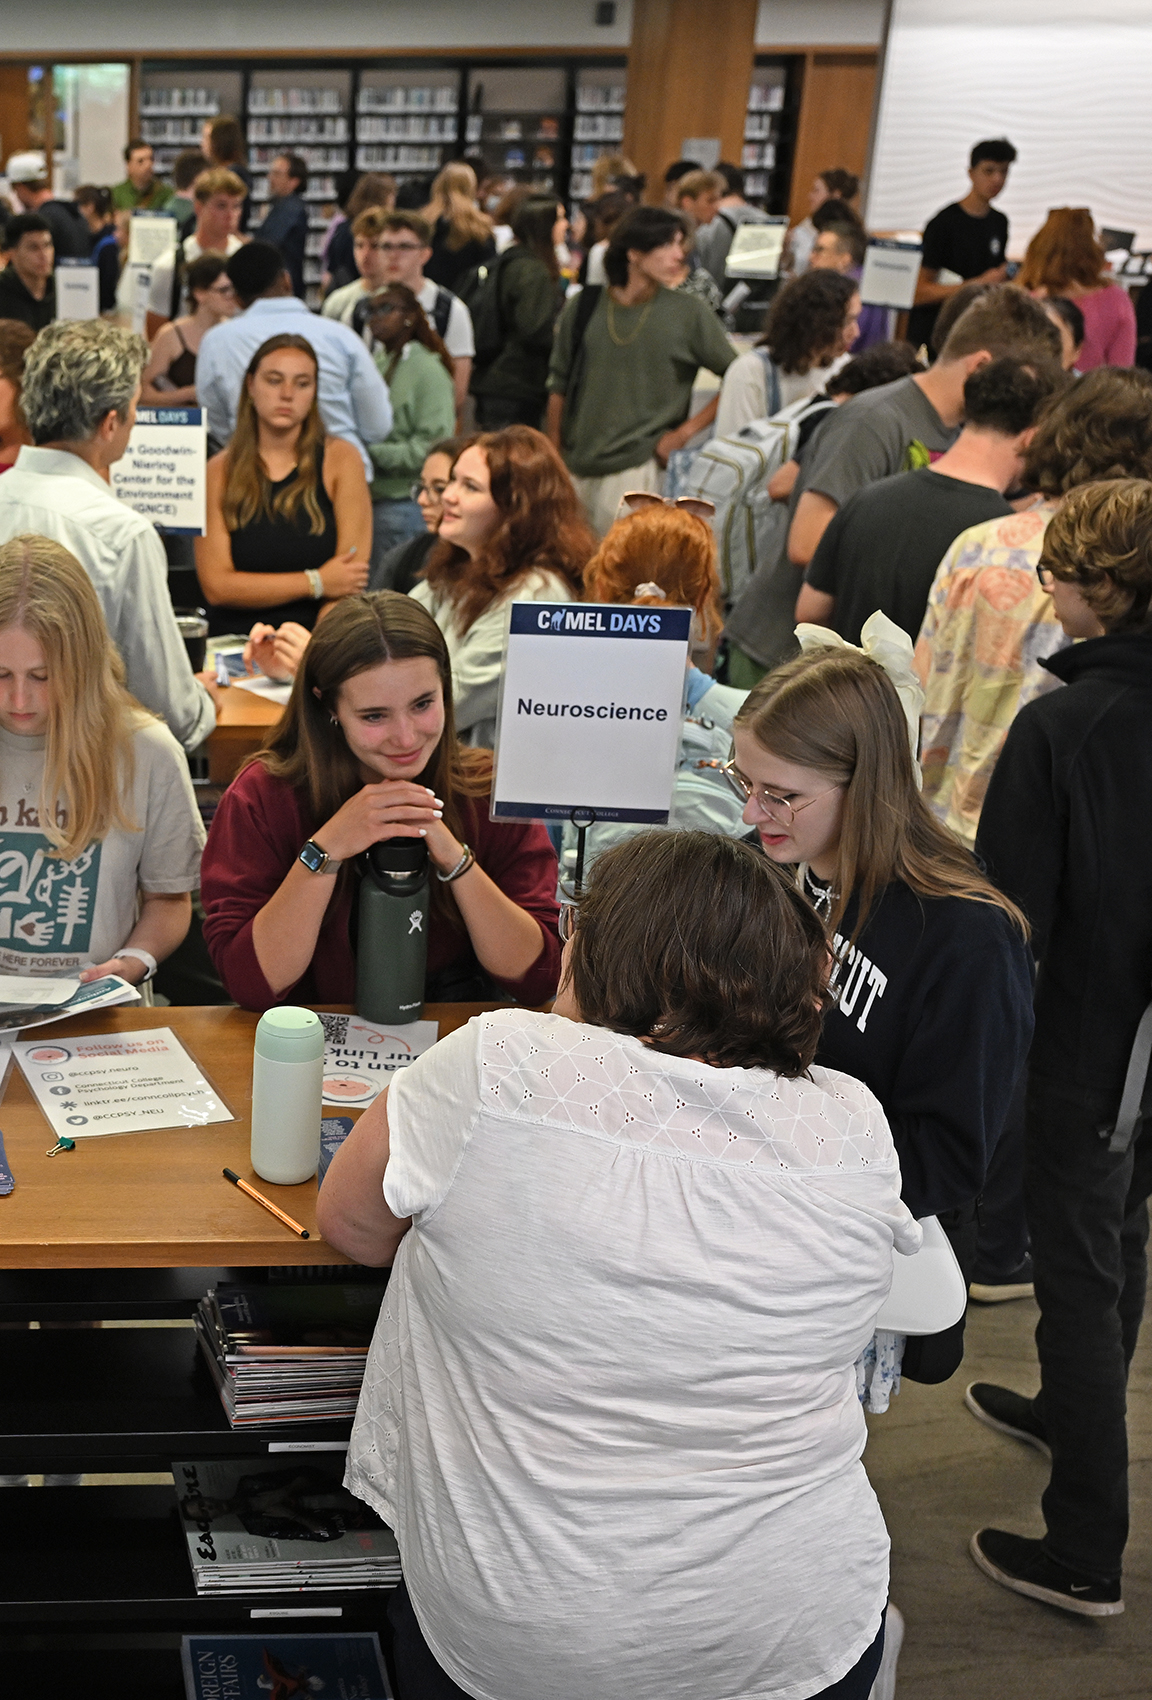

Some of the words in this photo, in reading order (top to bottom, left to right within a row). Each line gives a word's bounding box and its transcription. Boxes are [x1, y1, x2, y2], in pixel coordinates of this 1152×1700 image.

[136, 410, 158, 423] MEL
[158, 410, 189, 424] DAYS
[138, 444, 197, 454] Goodwin-
[132, 460, 176, 472] Niering
[113, 474, 152, 484] Center
[156, 474, 172, 484] for
[176, 476, 195, 485] the
[116, 488, 193, 500] Environment
[609, 613, 662, 634] DAYS
[516, 698, 668, 721] Neuroscience
[544, 807, 590, 816] CONNECICUT
[2, 954, 28, 966] HERE
[30, 957, 80, 967] FOREVER
[76, 1043, 124, 1053] Follow
[78, 1049, 122, 1059] Social
[126, 1045, 170, 1056] Media
[325, 1048, 378, 1060] Link
[335, 1060, 360, 1070] to
[368, 1062, 408, 1072] an
[75, 1080, 129, 1088] Connecticut
[130, 1076, 164, 1084] College
[78, 1084, 128, 1093] Psychology
[130, 1078, 184, 1089] Department
[84, 1090, 205, 1106] linktr.ee/conncollpsych
[92, 1108, 165, 1121] @CCPSY_NEU
[196, 1651, 221, 1700] REIGN
